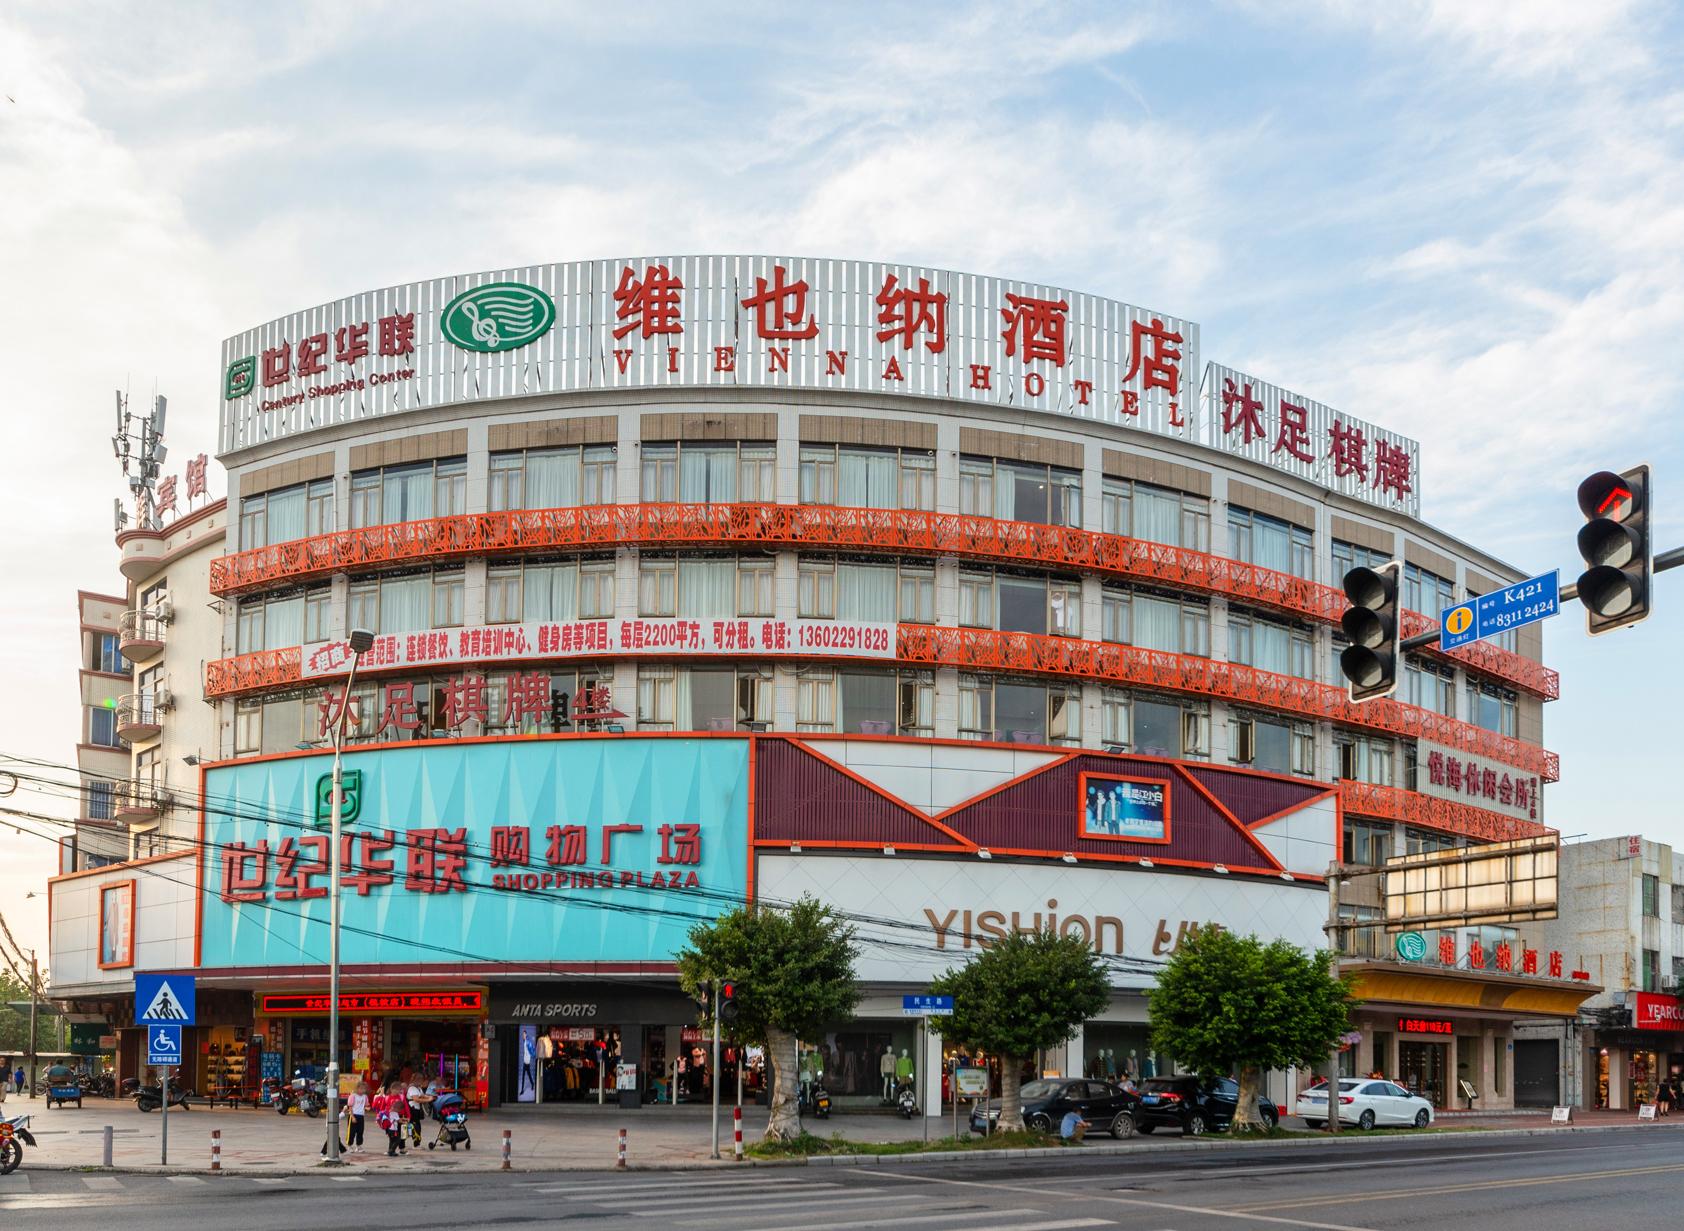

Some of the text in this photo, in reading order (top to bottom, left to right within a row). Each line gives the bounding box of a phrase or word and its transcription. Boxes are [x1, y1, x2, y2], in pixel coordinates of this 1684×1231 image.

[262, 312, 415, 388] 世纪华联
[612, 264, 1184, 398] 维也纳酒店
[308, 377, 365, 400] Shopping
[612, 346, 1186, 428] VIENNA HOTEL
[1222, 377, 1412, 501] 沐足棋牌
[1496, 610, 1522, 627] 8311
[1524, 599, 1554, 617] 2424
[1504, 582, 1542, 605] K421
[220, 822, 702, 903] 世纪华联 购物广场
[491, 870, 701, 891] SHOPPING PLAZA
[1439, 936, 1563, 978] 维也纳酒店
[512, 1004, 598, 1017] ANTA SPORTS
